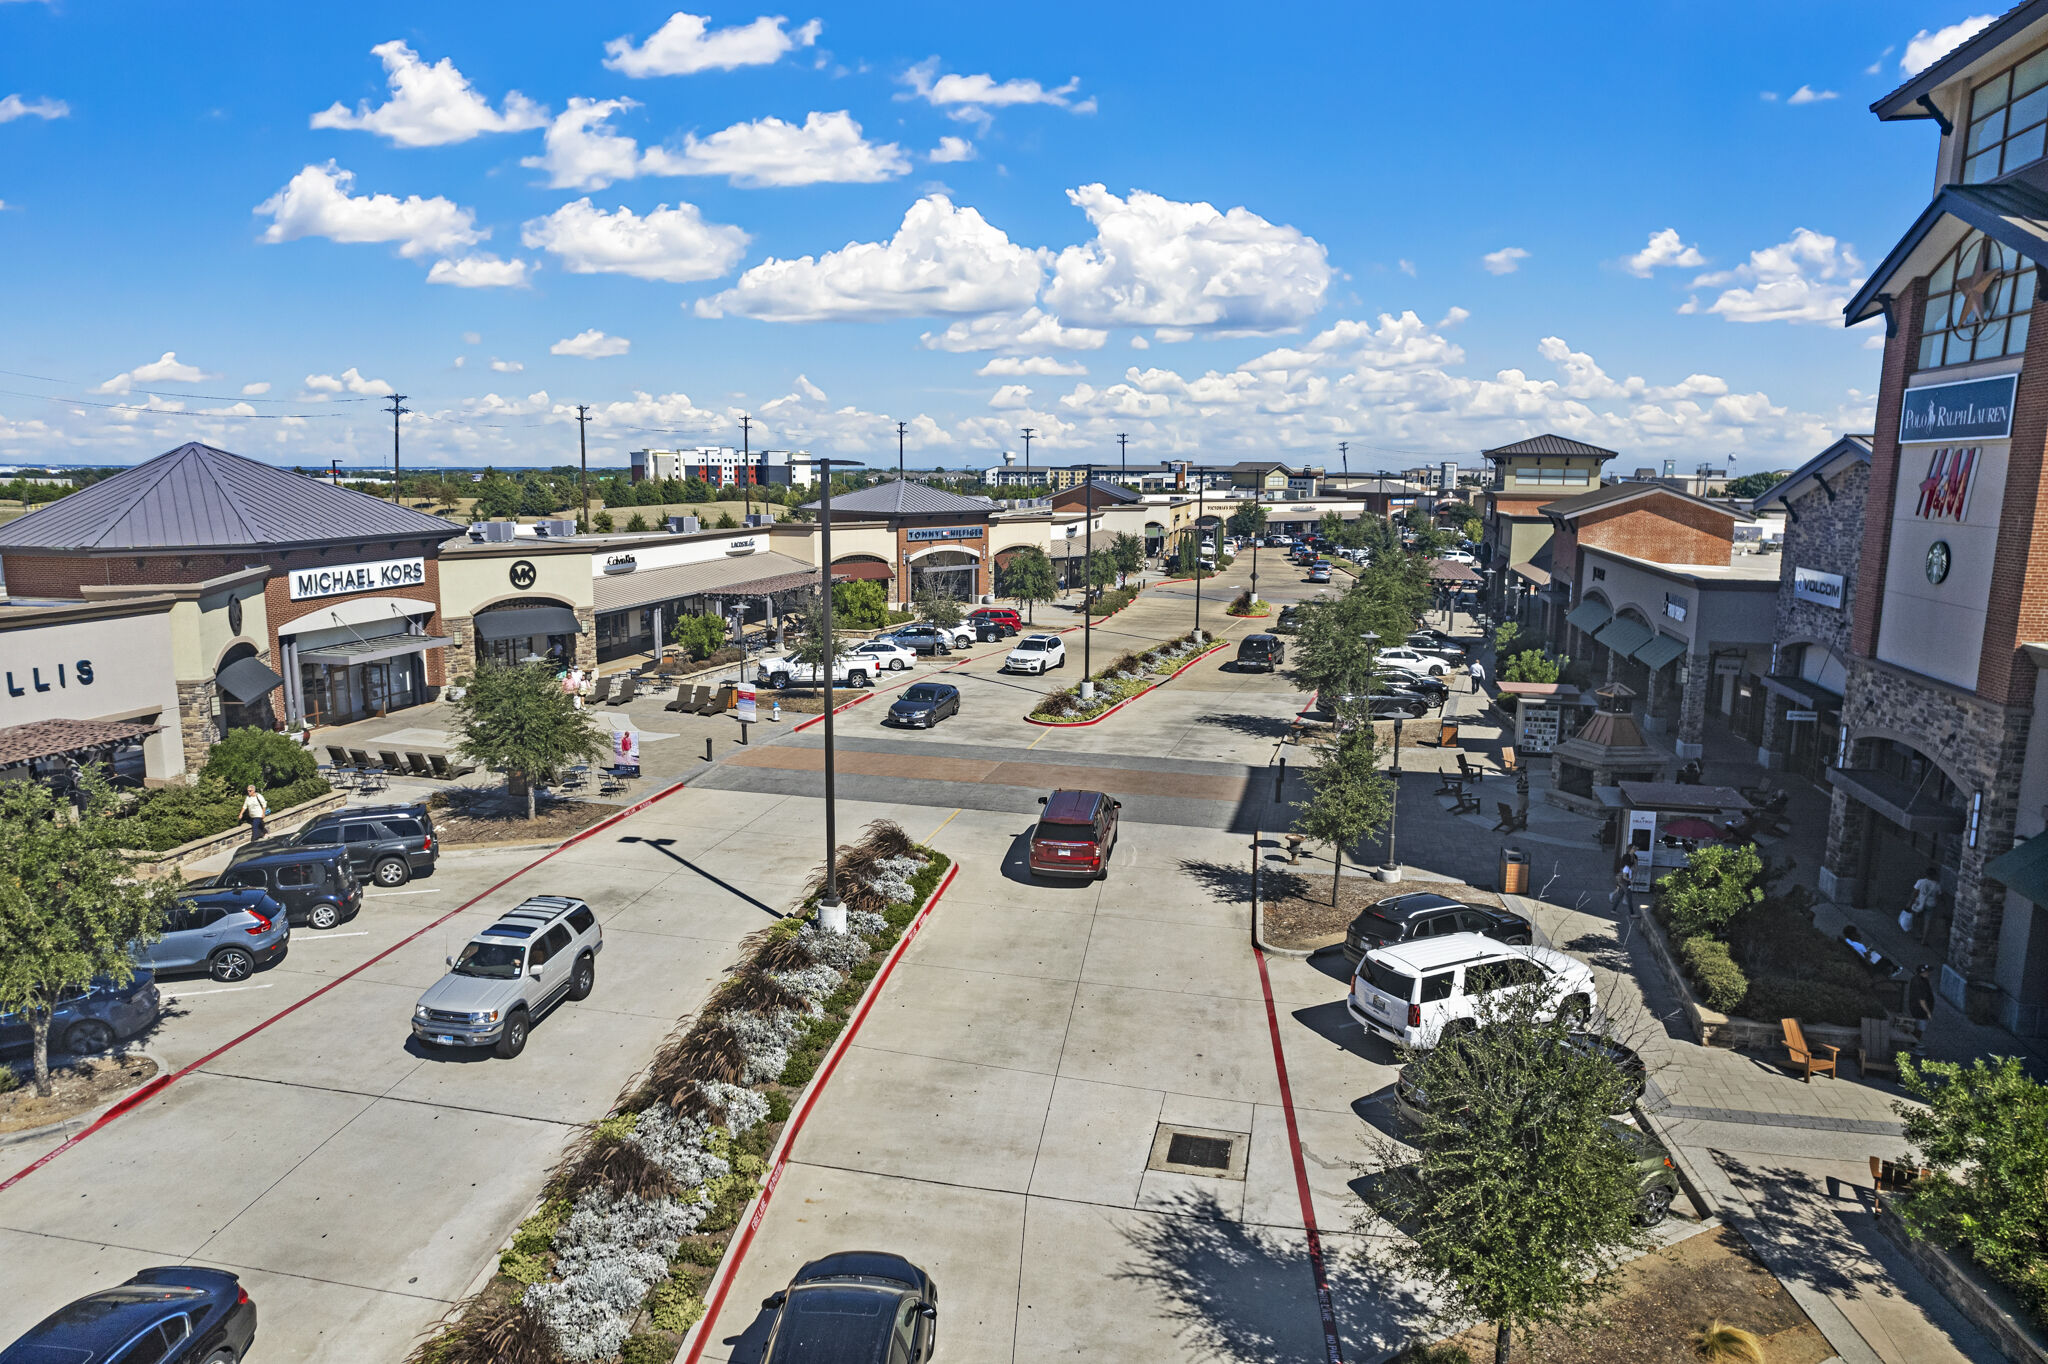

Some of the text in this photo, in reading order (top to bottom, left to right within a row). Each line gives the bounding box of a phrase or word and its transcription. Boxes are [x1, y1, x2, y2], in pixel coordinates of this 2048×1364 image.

[1905, 403, 2007, 429] POLO RALPH LAUREN
[908, 528, 983, 539] TOMMY HILFIGER
[298, 562, 422, 593] MICHAEL KORS
[1804, 578, 1840, 598] VOLCOM
[6, 659, 94, 698] LLIS
[751, 1212, 761, 1231] FIRE
[757, 1197, 767, 1217] LANE
[772, 1161, 783, 1186] PARKING
[1326, 1334, 1337, 1345] NO
